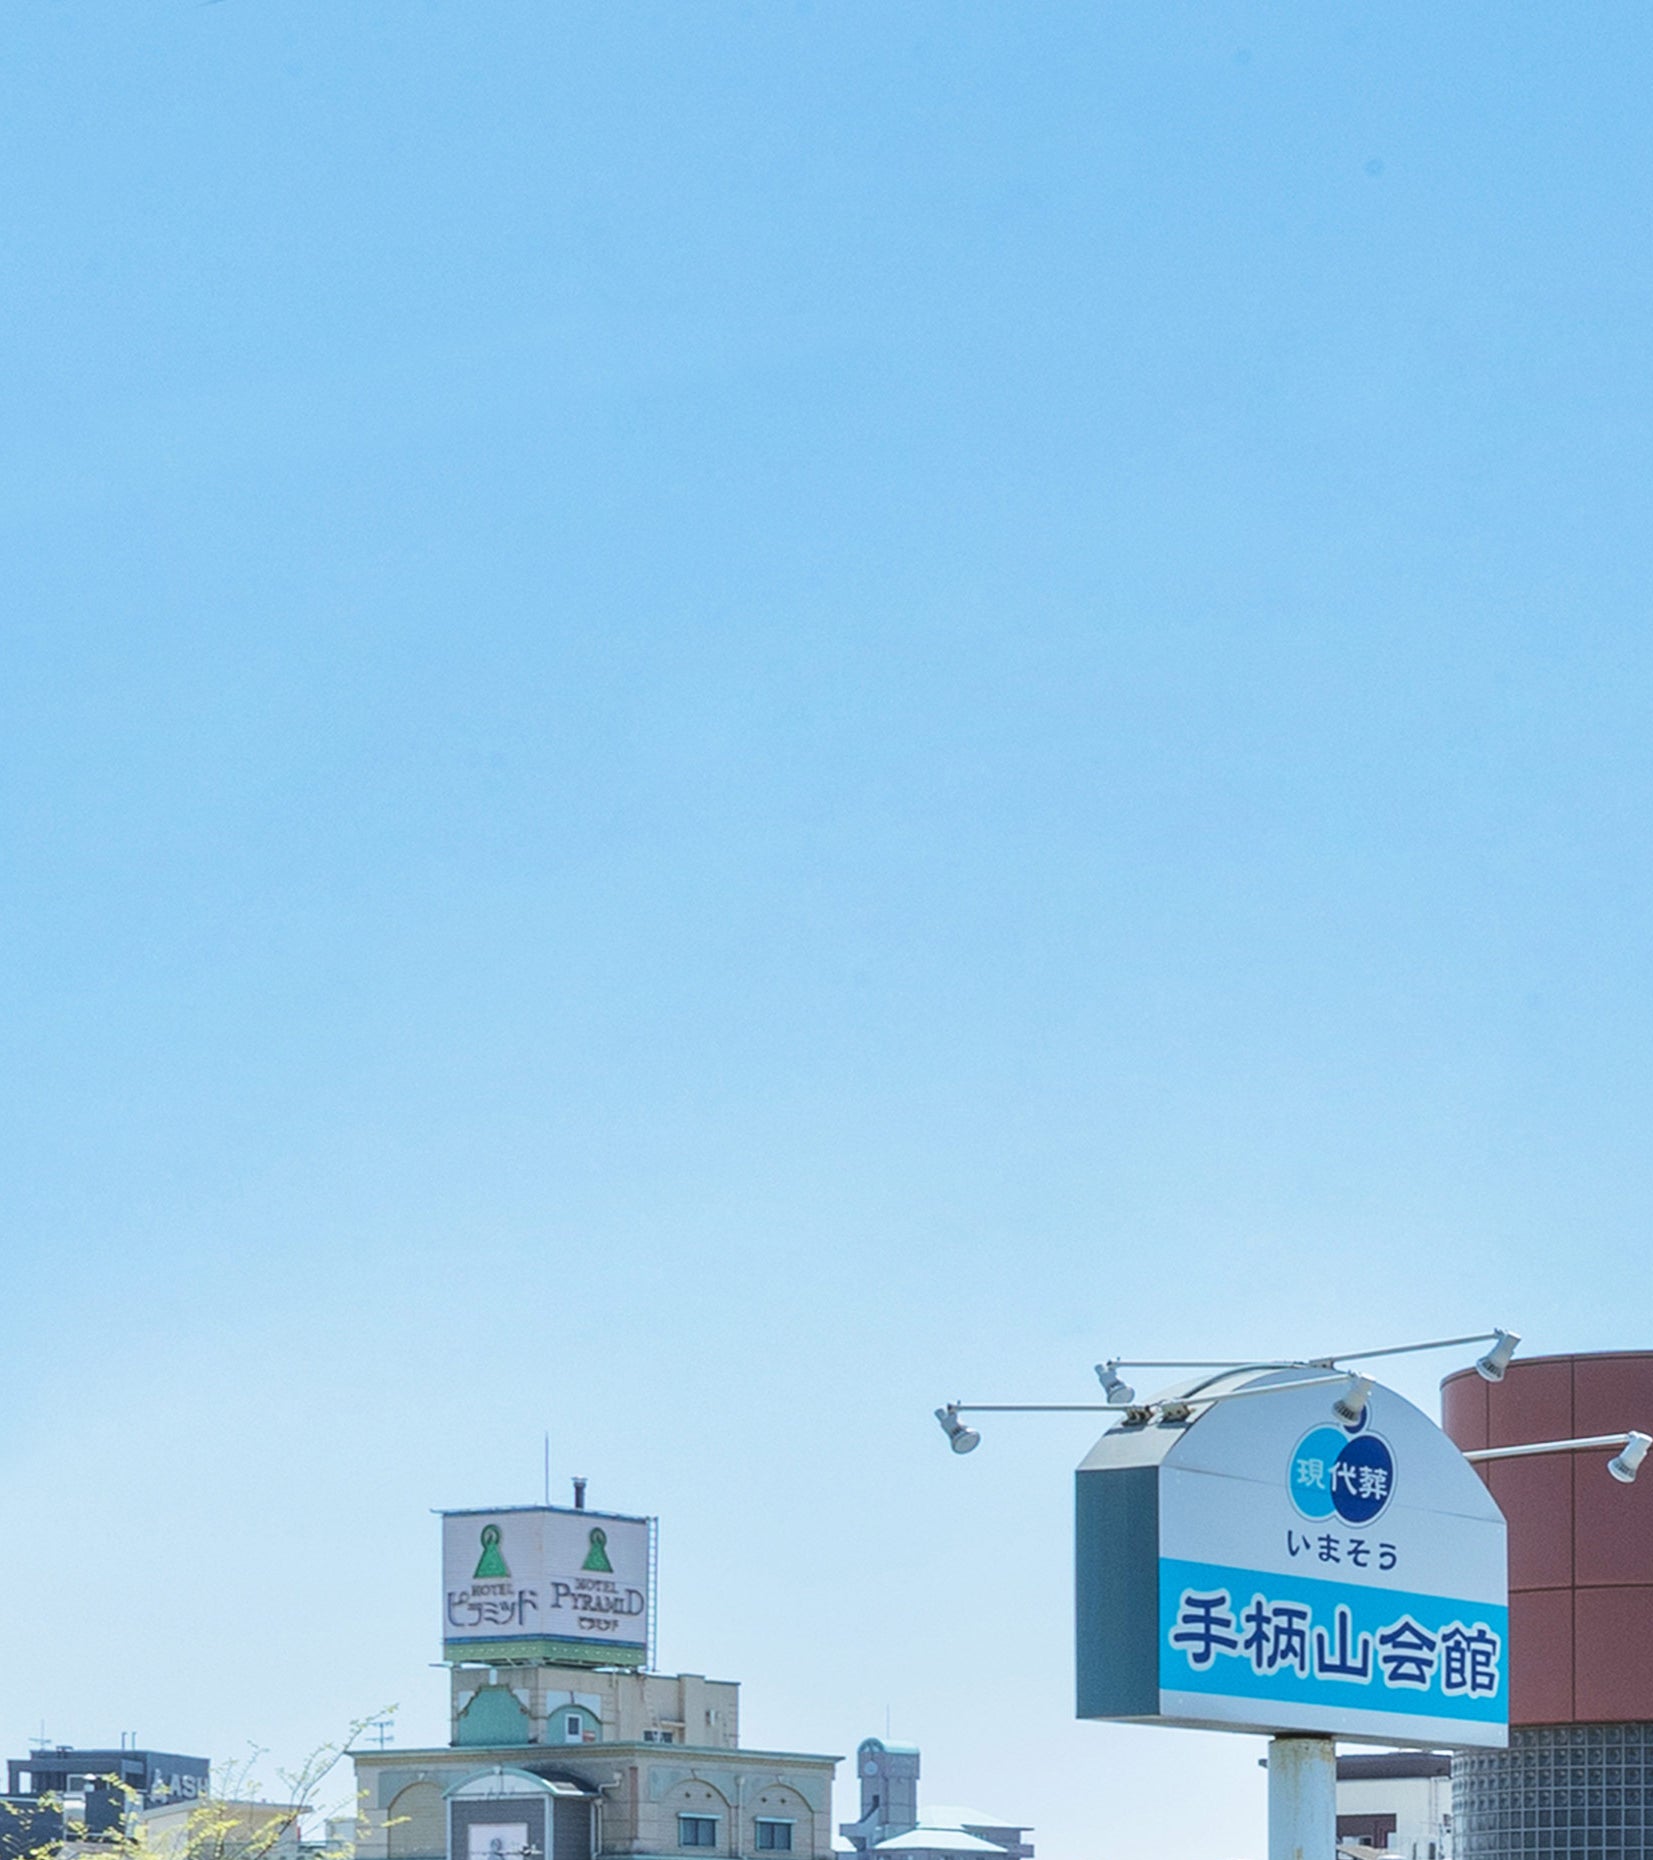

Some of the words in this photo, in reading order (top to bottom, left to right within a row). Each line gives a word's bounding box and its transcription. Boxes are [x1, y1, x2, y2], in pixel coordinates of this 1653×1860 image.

[1296, 1457, 1389, 1501] 現代葬
[1287, 1528, 1398, 1571] いまそう
[471, 1583, 515, 1596] HOTEL
[551, 1581, 645, 1616] PYRAMID
[575, 1577, 618, 1594] HOTEL
[1171, 1591, 1499, 1695] 手柄山会館
